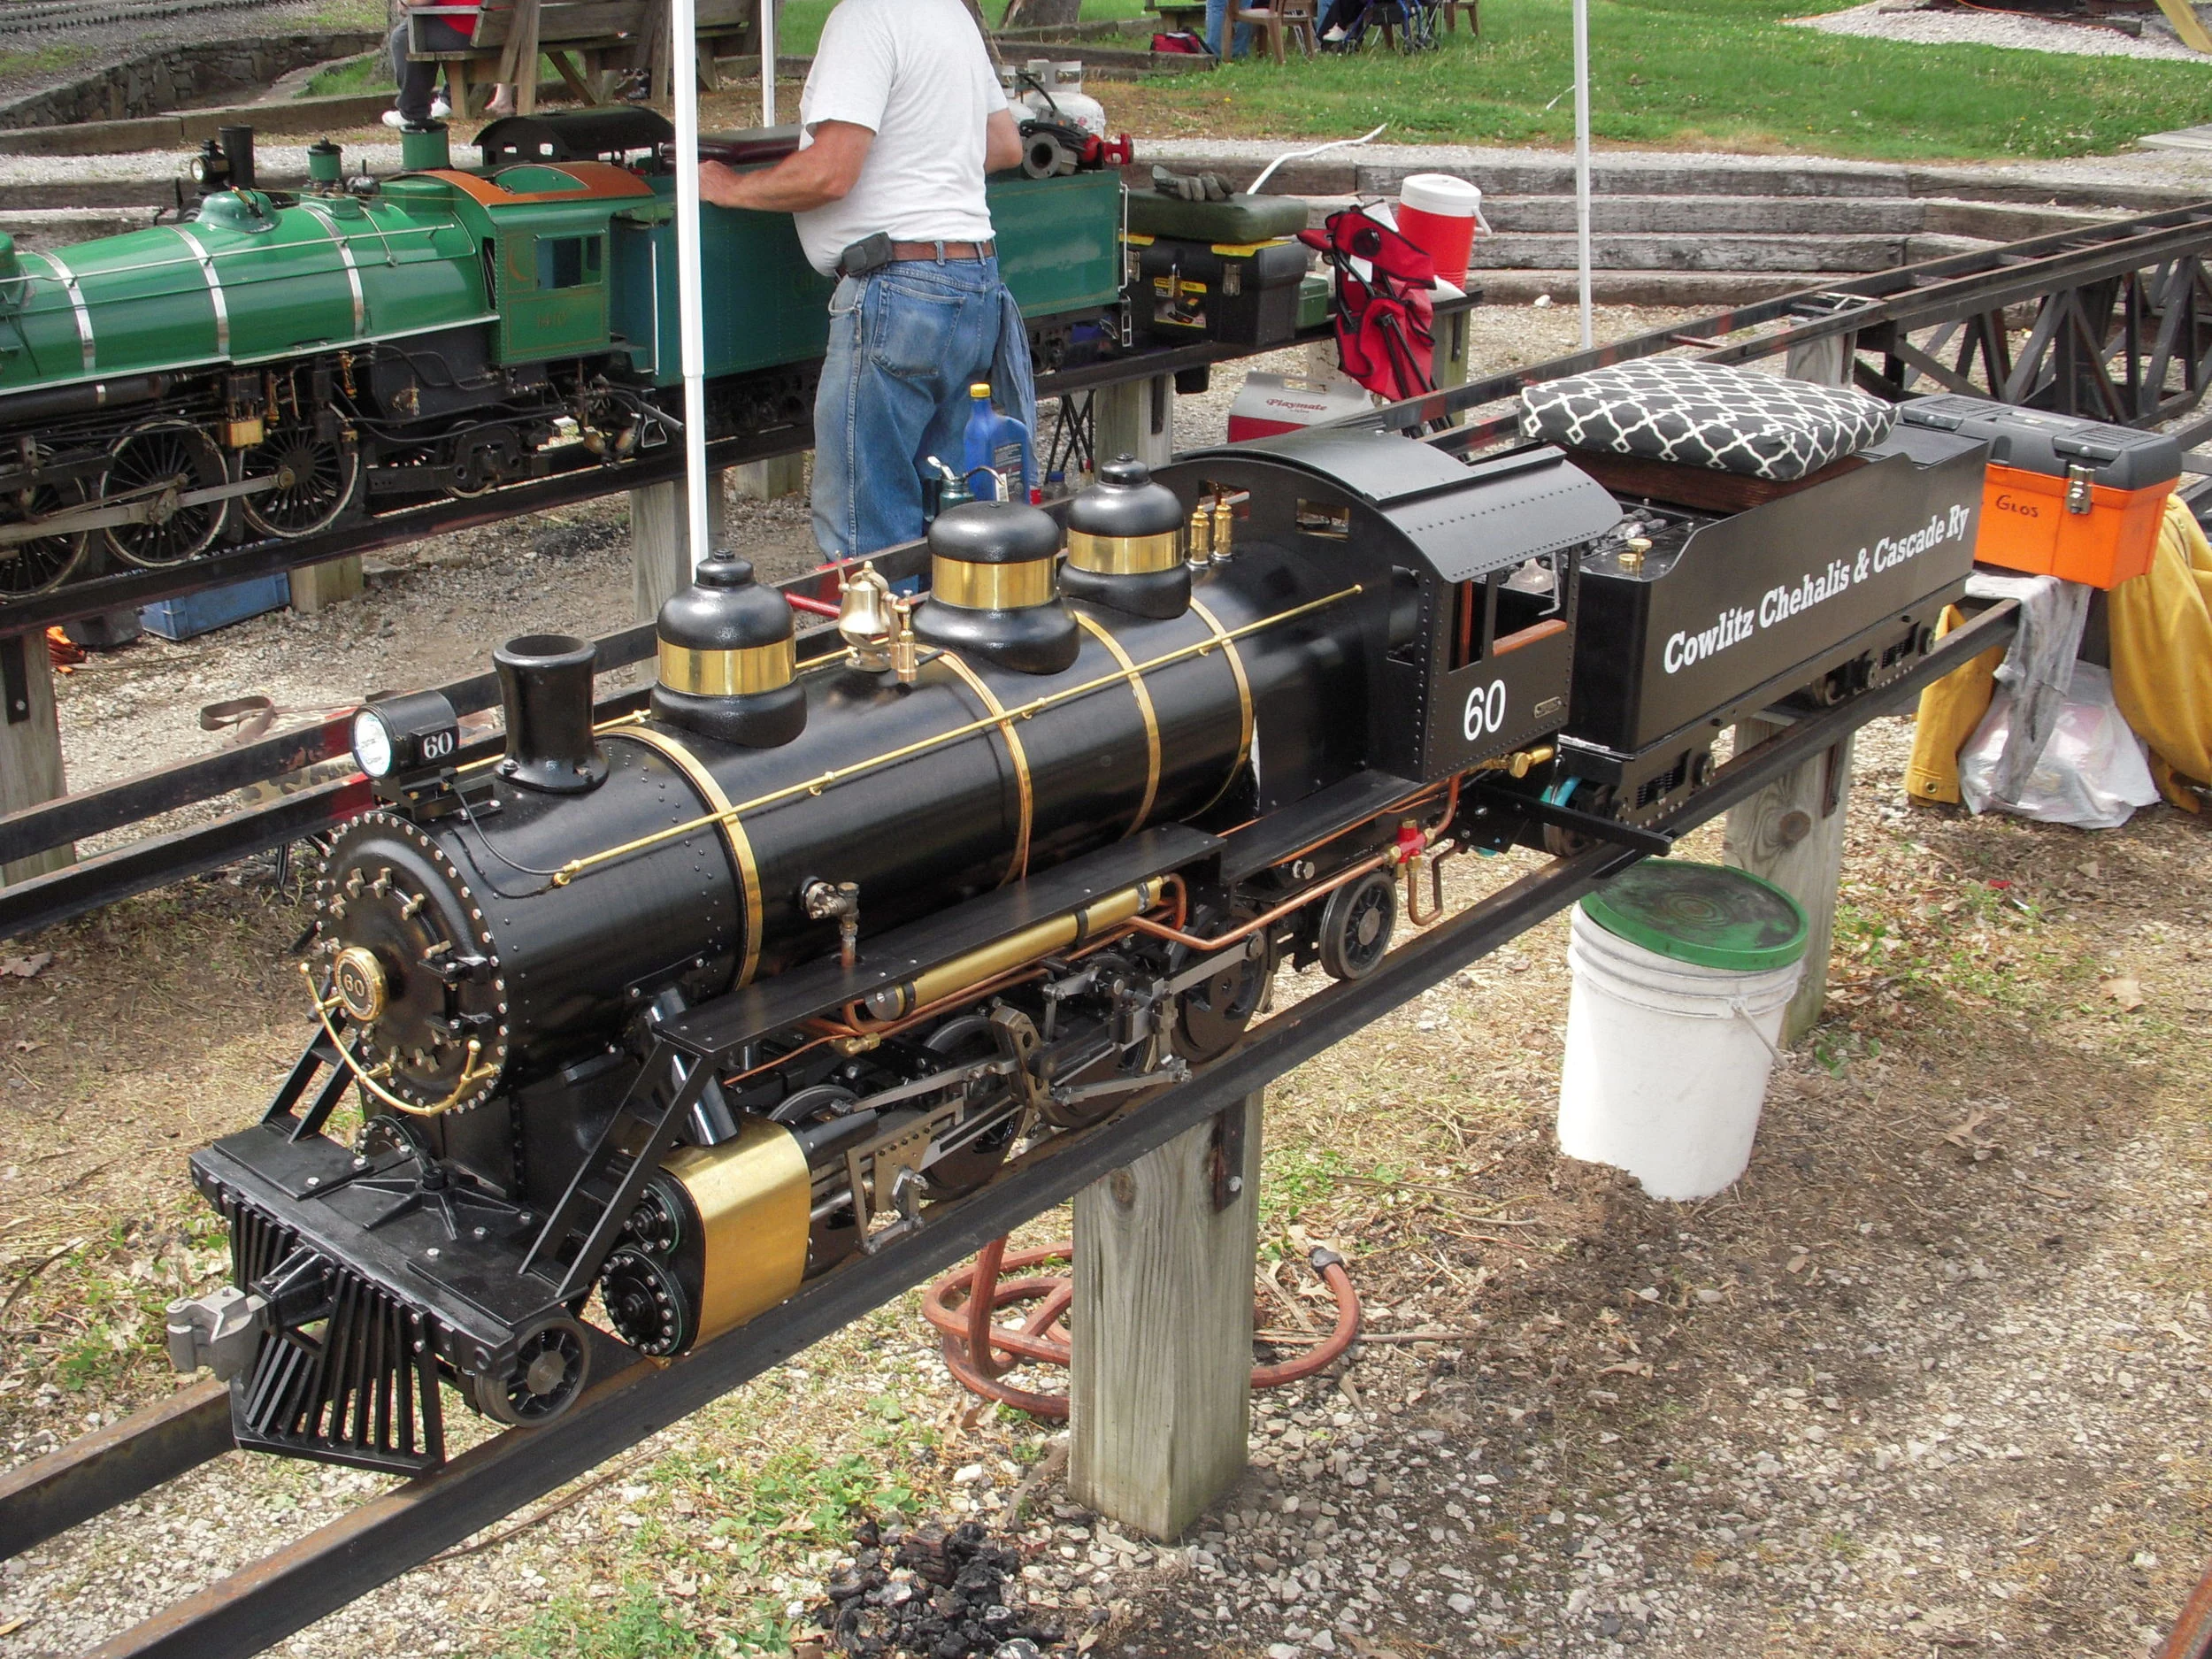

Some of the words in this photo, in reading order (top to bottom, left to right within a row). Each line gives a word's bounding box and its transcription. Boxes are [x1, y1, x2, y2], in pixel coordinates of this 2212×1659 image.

[1266, 398, 1327, 411] Playmate
[1663, 606, 1755, 674] Cowlitz
[1759, 559, 1851, 628] Chehalis
[1853, 548, 1870, 584] &
[1873, 515, 1945, 573] Cascade
[1947, 504, 1970, 541] Ry
[1463, 679, 1506, 741] 60
[423, 732, 453, 758] 60
[343, 973, 365, 998] 60
